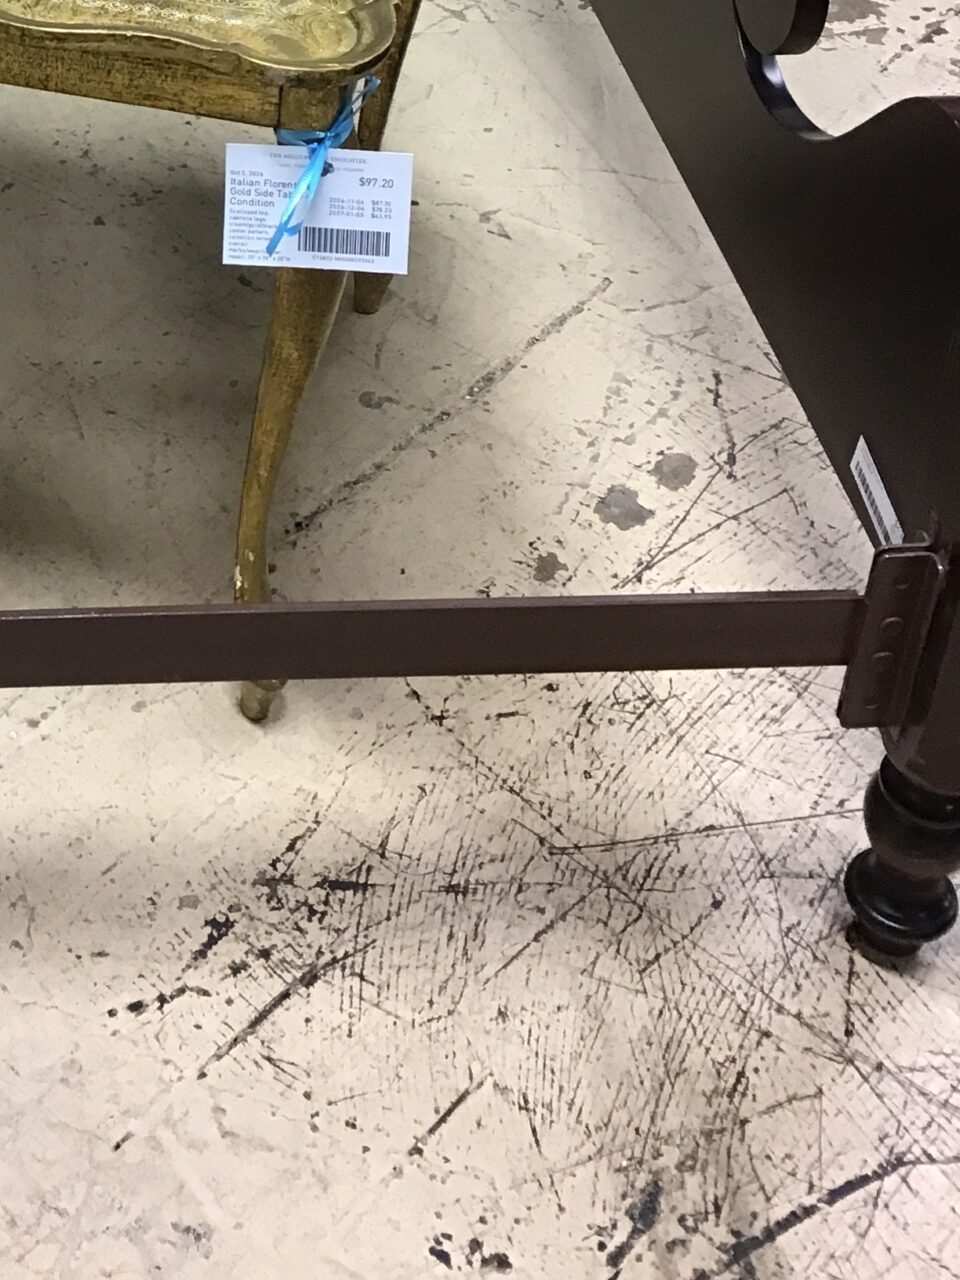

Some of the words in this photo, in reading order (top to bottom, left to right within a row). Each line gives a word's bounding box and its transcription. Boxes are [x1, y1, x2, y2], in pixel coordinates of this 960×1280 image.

[230, 177, 261, 187] Italian
[263, 179, 297, 190] Florent
[359, 176, 394, 189] $97.20
[230, 186, 252, 197] Gold
[254, 188, 275, 198] Side
[230, 196, 275, 208] Condition
